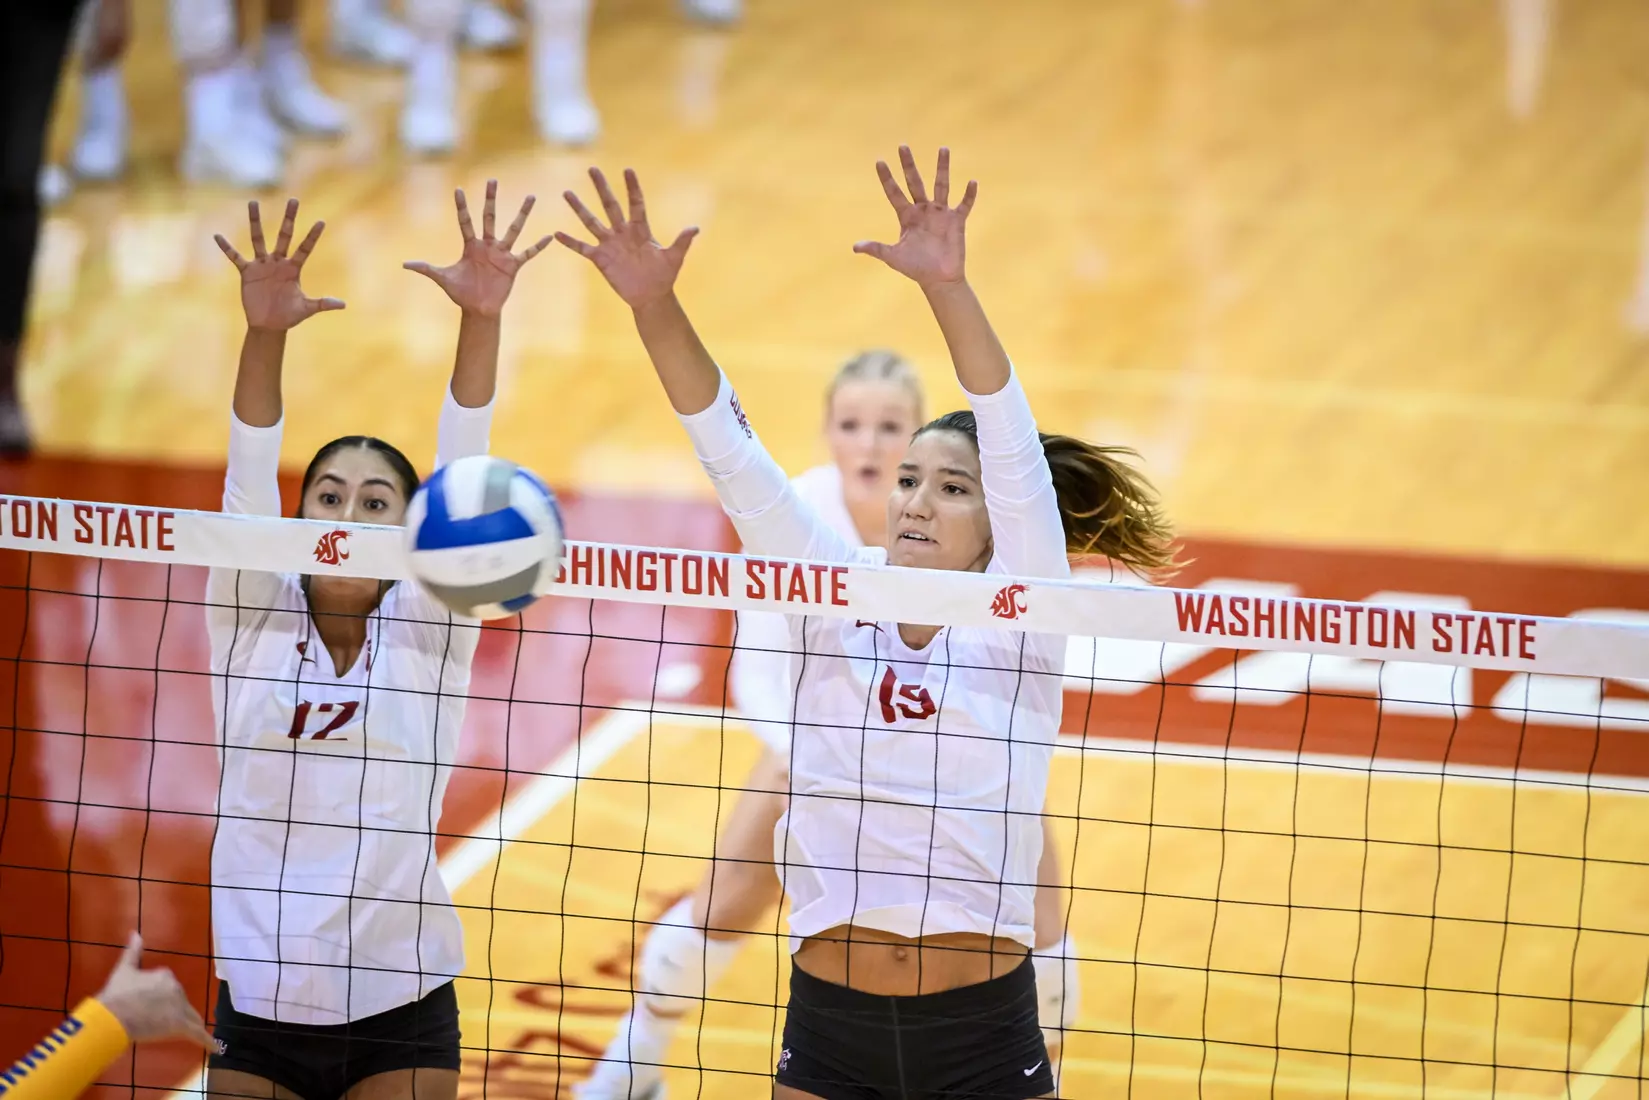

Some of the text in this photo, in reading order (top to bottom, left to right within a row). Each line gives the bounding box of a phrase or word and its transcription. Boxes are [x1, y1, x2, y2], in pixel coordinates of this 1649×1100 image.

[74, 504, 175, 551] STATE
[745, 558, 849, 606] STATE
[1173, 591, 1537, 660] WASHINGTON STATE
